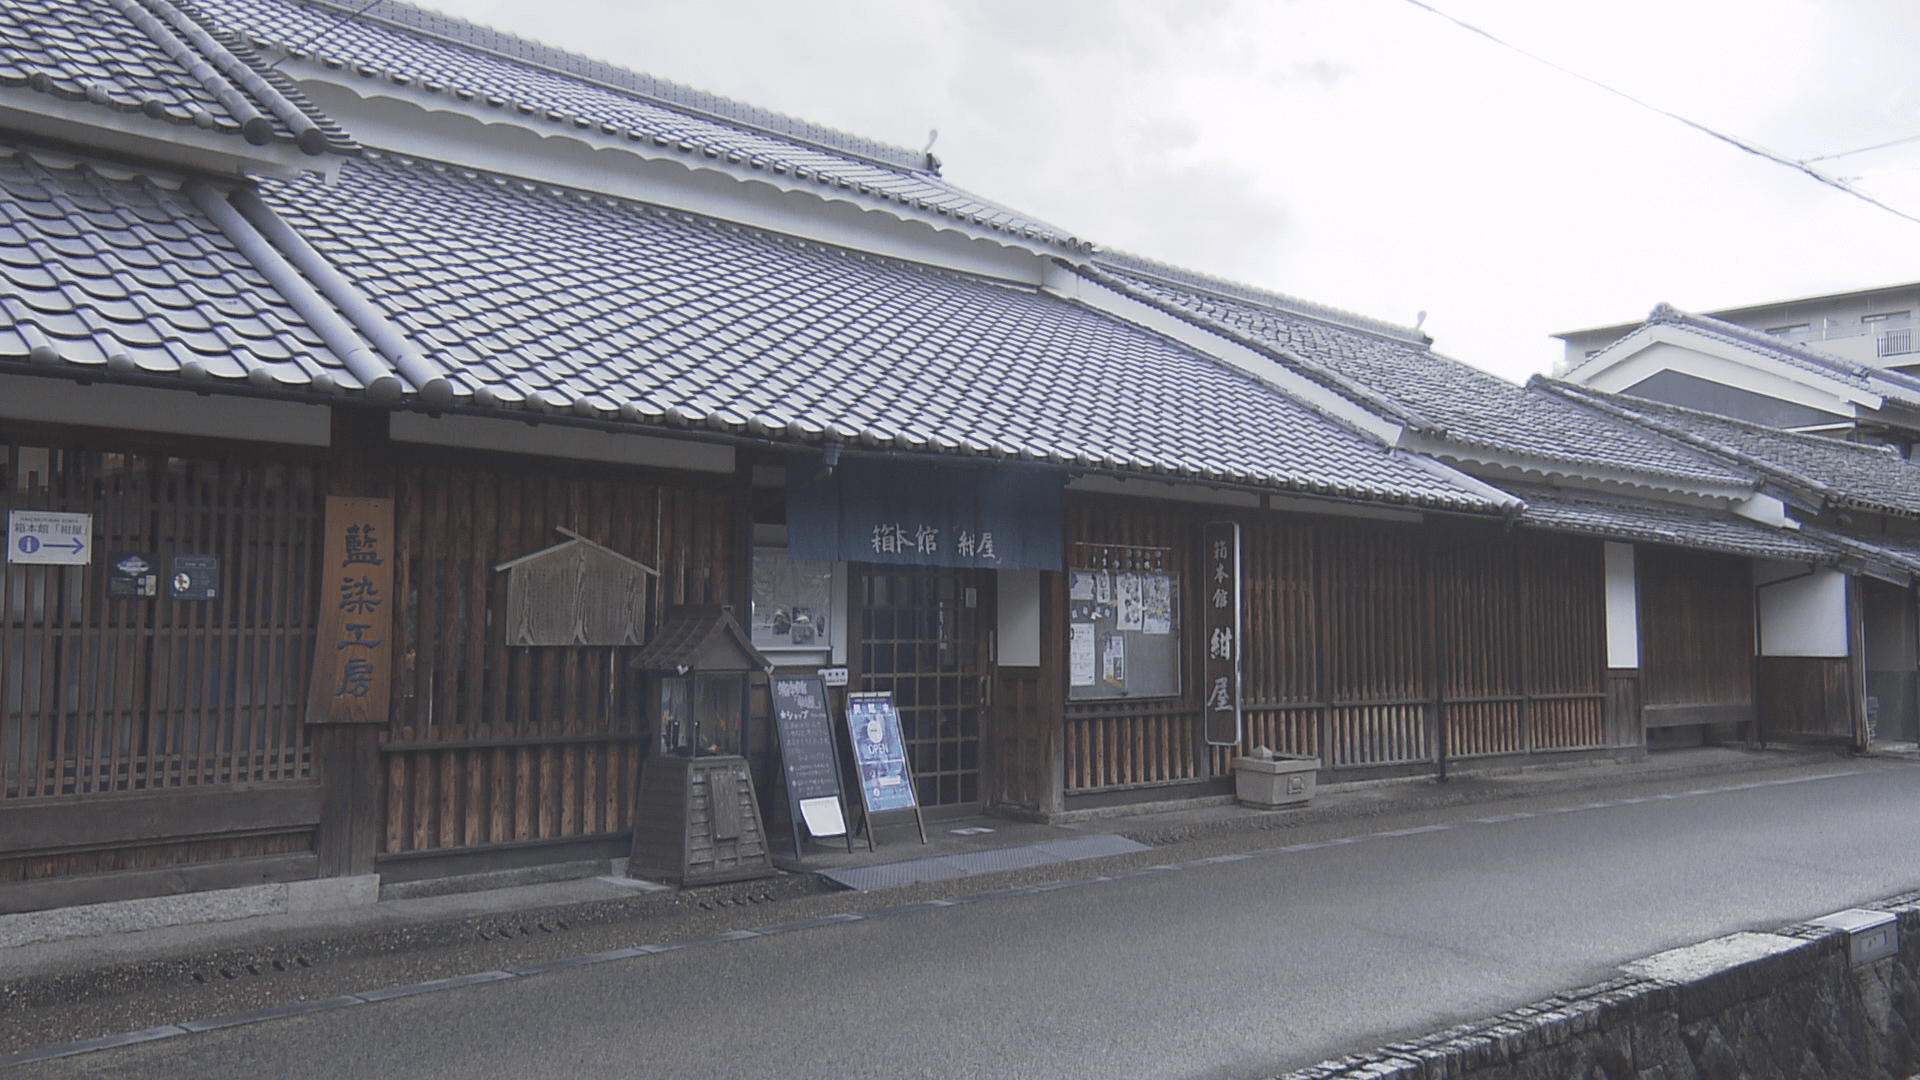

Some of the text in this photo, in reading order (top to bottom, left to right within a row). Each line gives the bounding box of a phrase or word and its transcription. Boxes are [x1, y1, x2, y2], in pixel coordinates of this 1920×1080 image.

[334, 524, 384, 698] 藍染工房
[1207, 627, 1234, 713] 紺屋
[867, 743, 889, 754] OPEN
